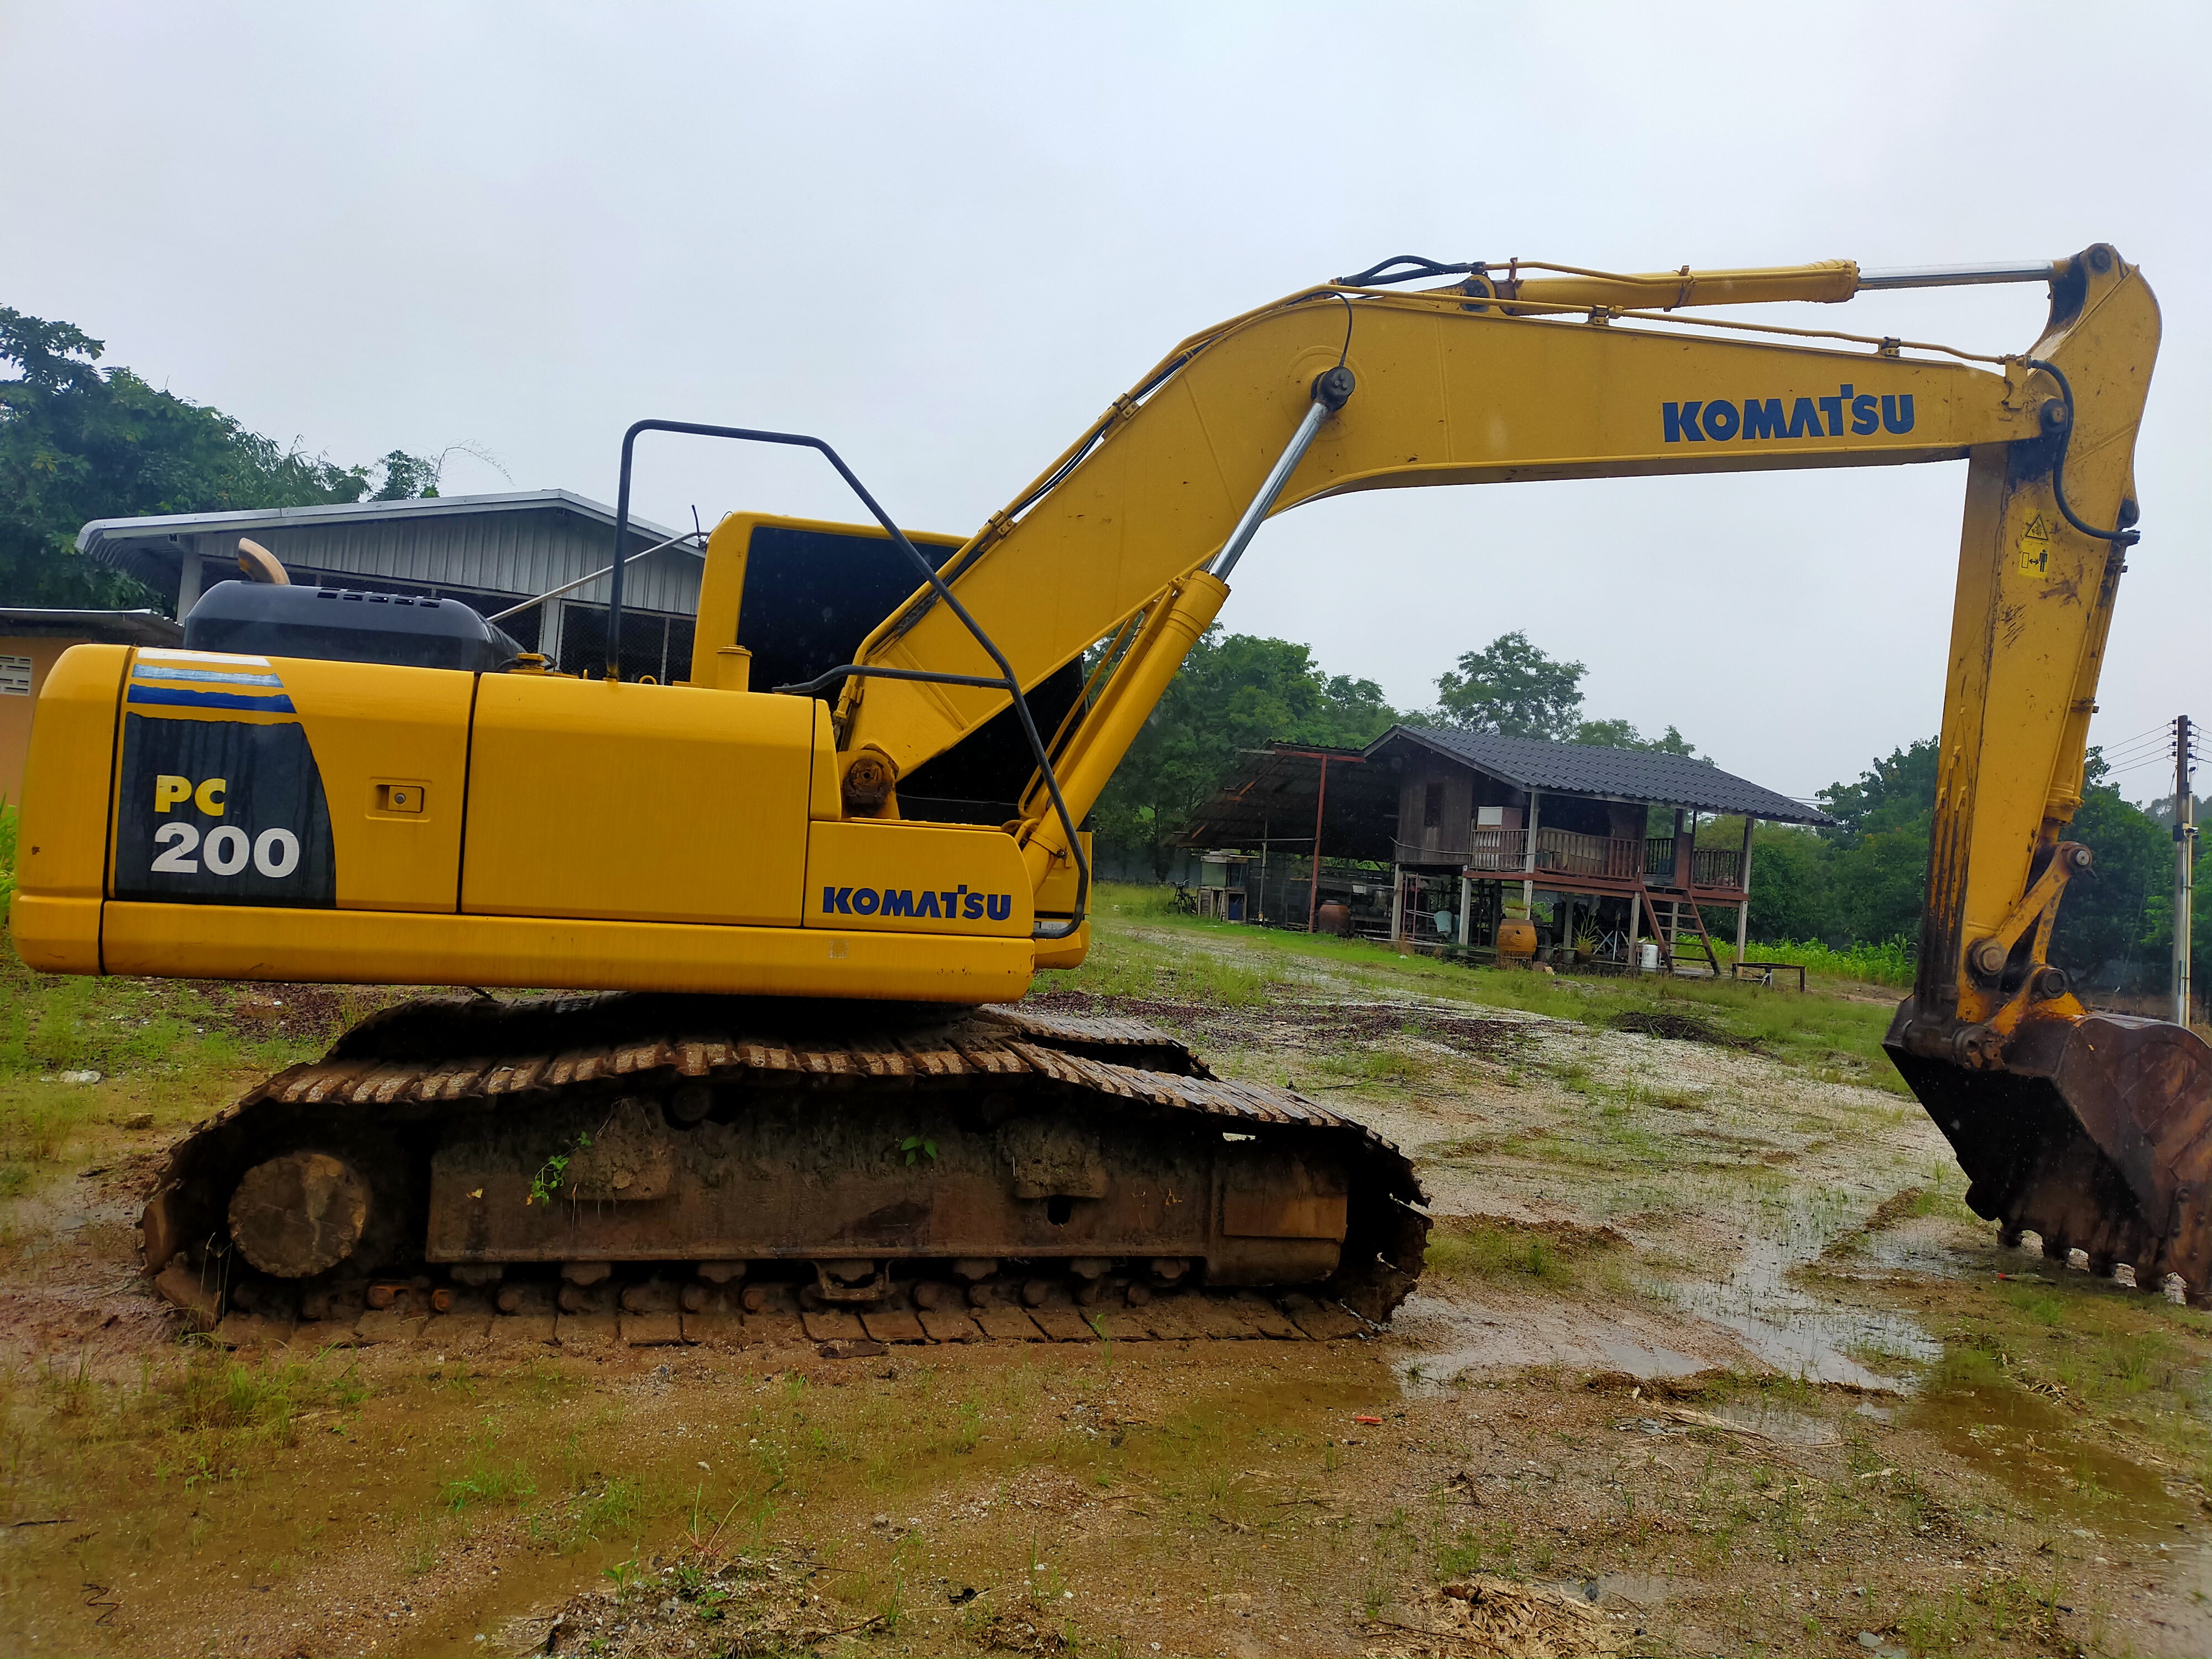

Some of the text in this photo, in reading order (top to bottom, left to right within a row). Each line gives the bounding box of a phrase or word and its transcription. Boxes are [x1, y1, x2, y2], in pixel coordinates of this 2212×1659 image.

[1662, 384, 1914, 442] KOMATSU
[155, 775, 226, 816] PC
[150, 822, 299, 878] 200
[822, 885, 1011, 920] KOMATSU
